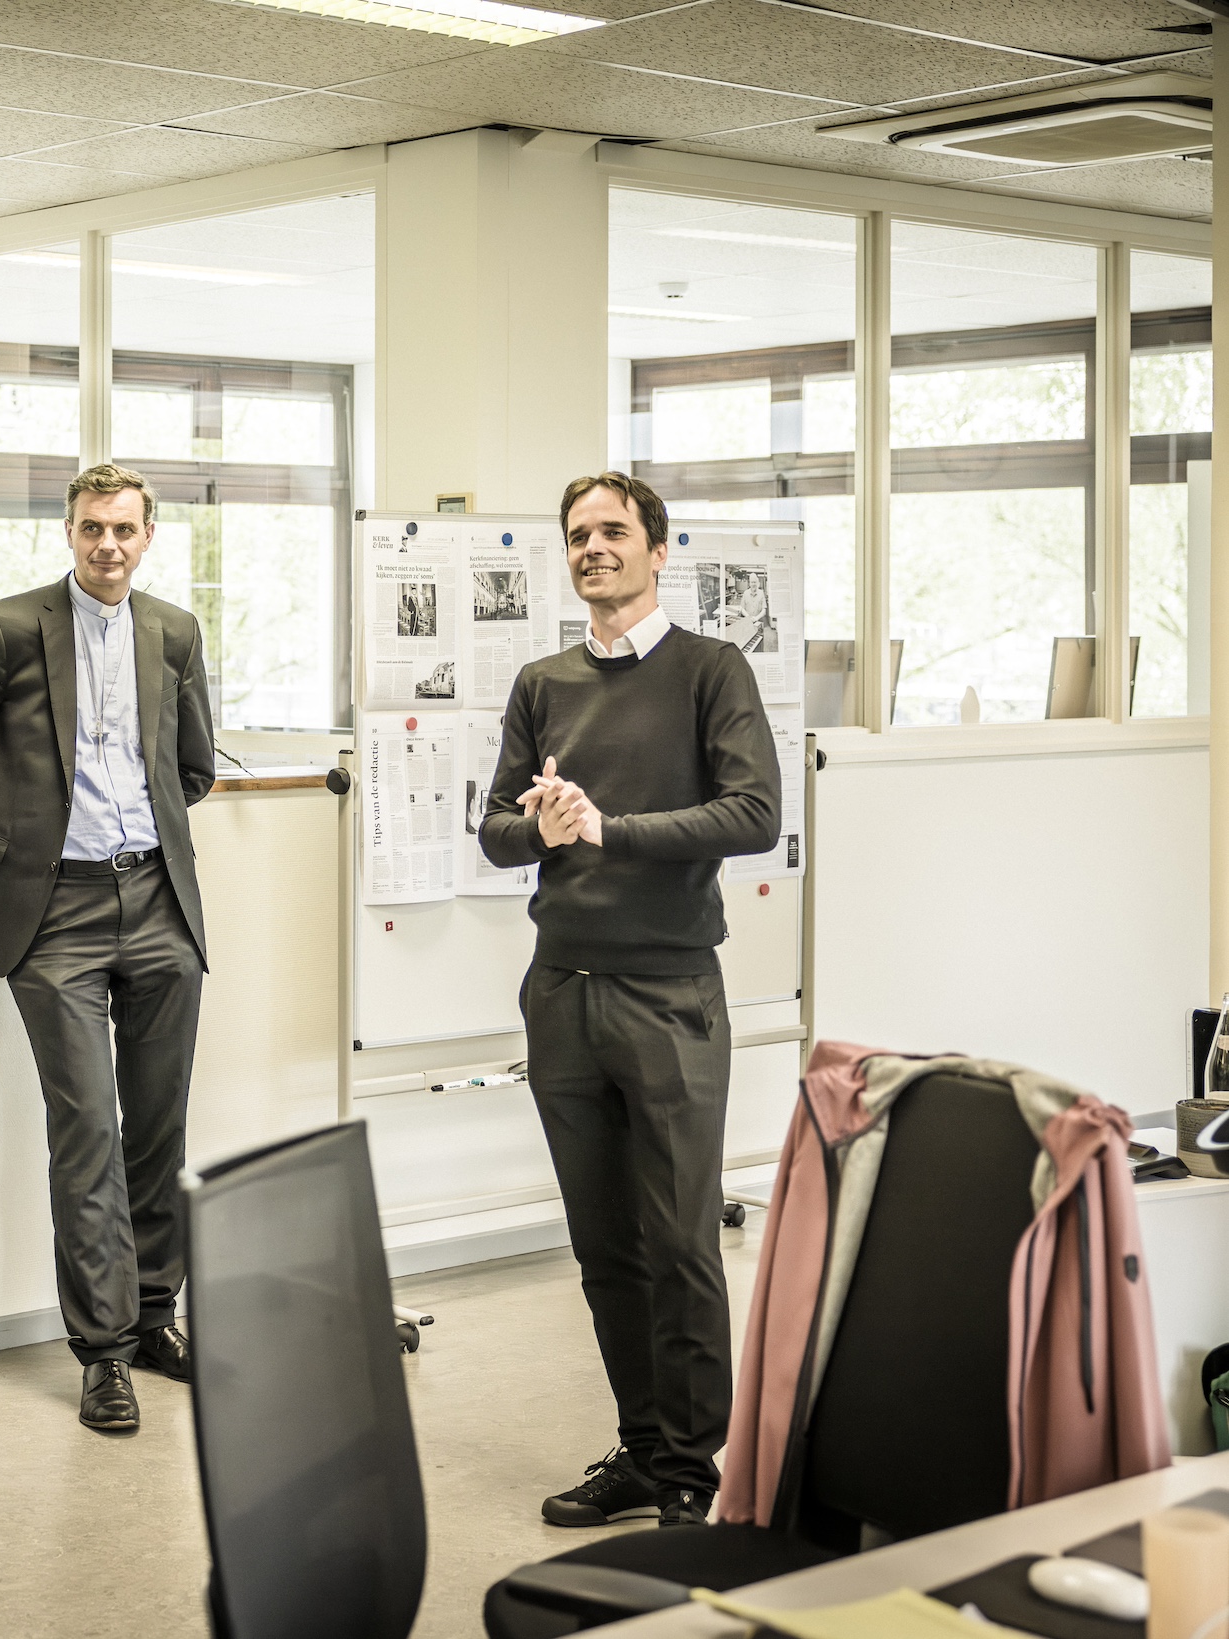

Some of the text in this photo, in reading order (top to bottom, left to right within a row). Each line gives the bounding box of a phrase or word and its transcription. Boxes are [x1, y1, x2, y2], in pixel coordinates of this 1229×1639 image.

[370, 740, 379, 783] redactie
[371, 785, 379, 799] de
[373, 801, 381, 821] van
[373, 823, 383, 848] Tips
